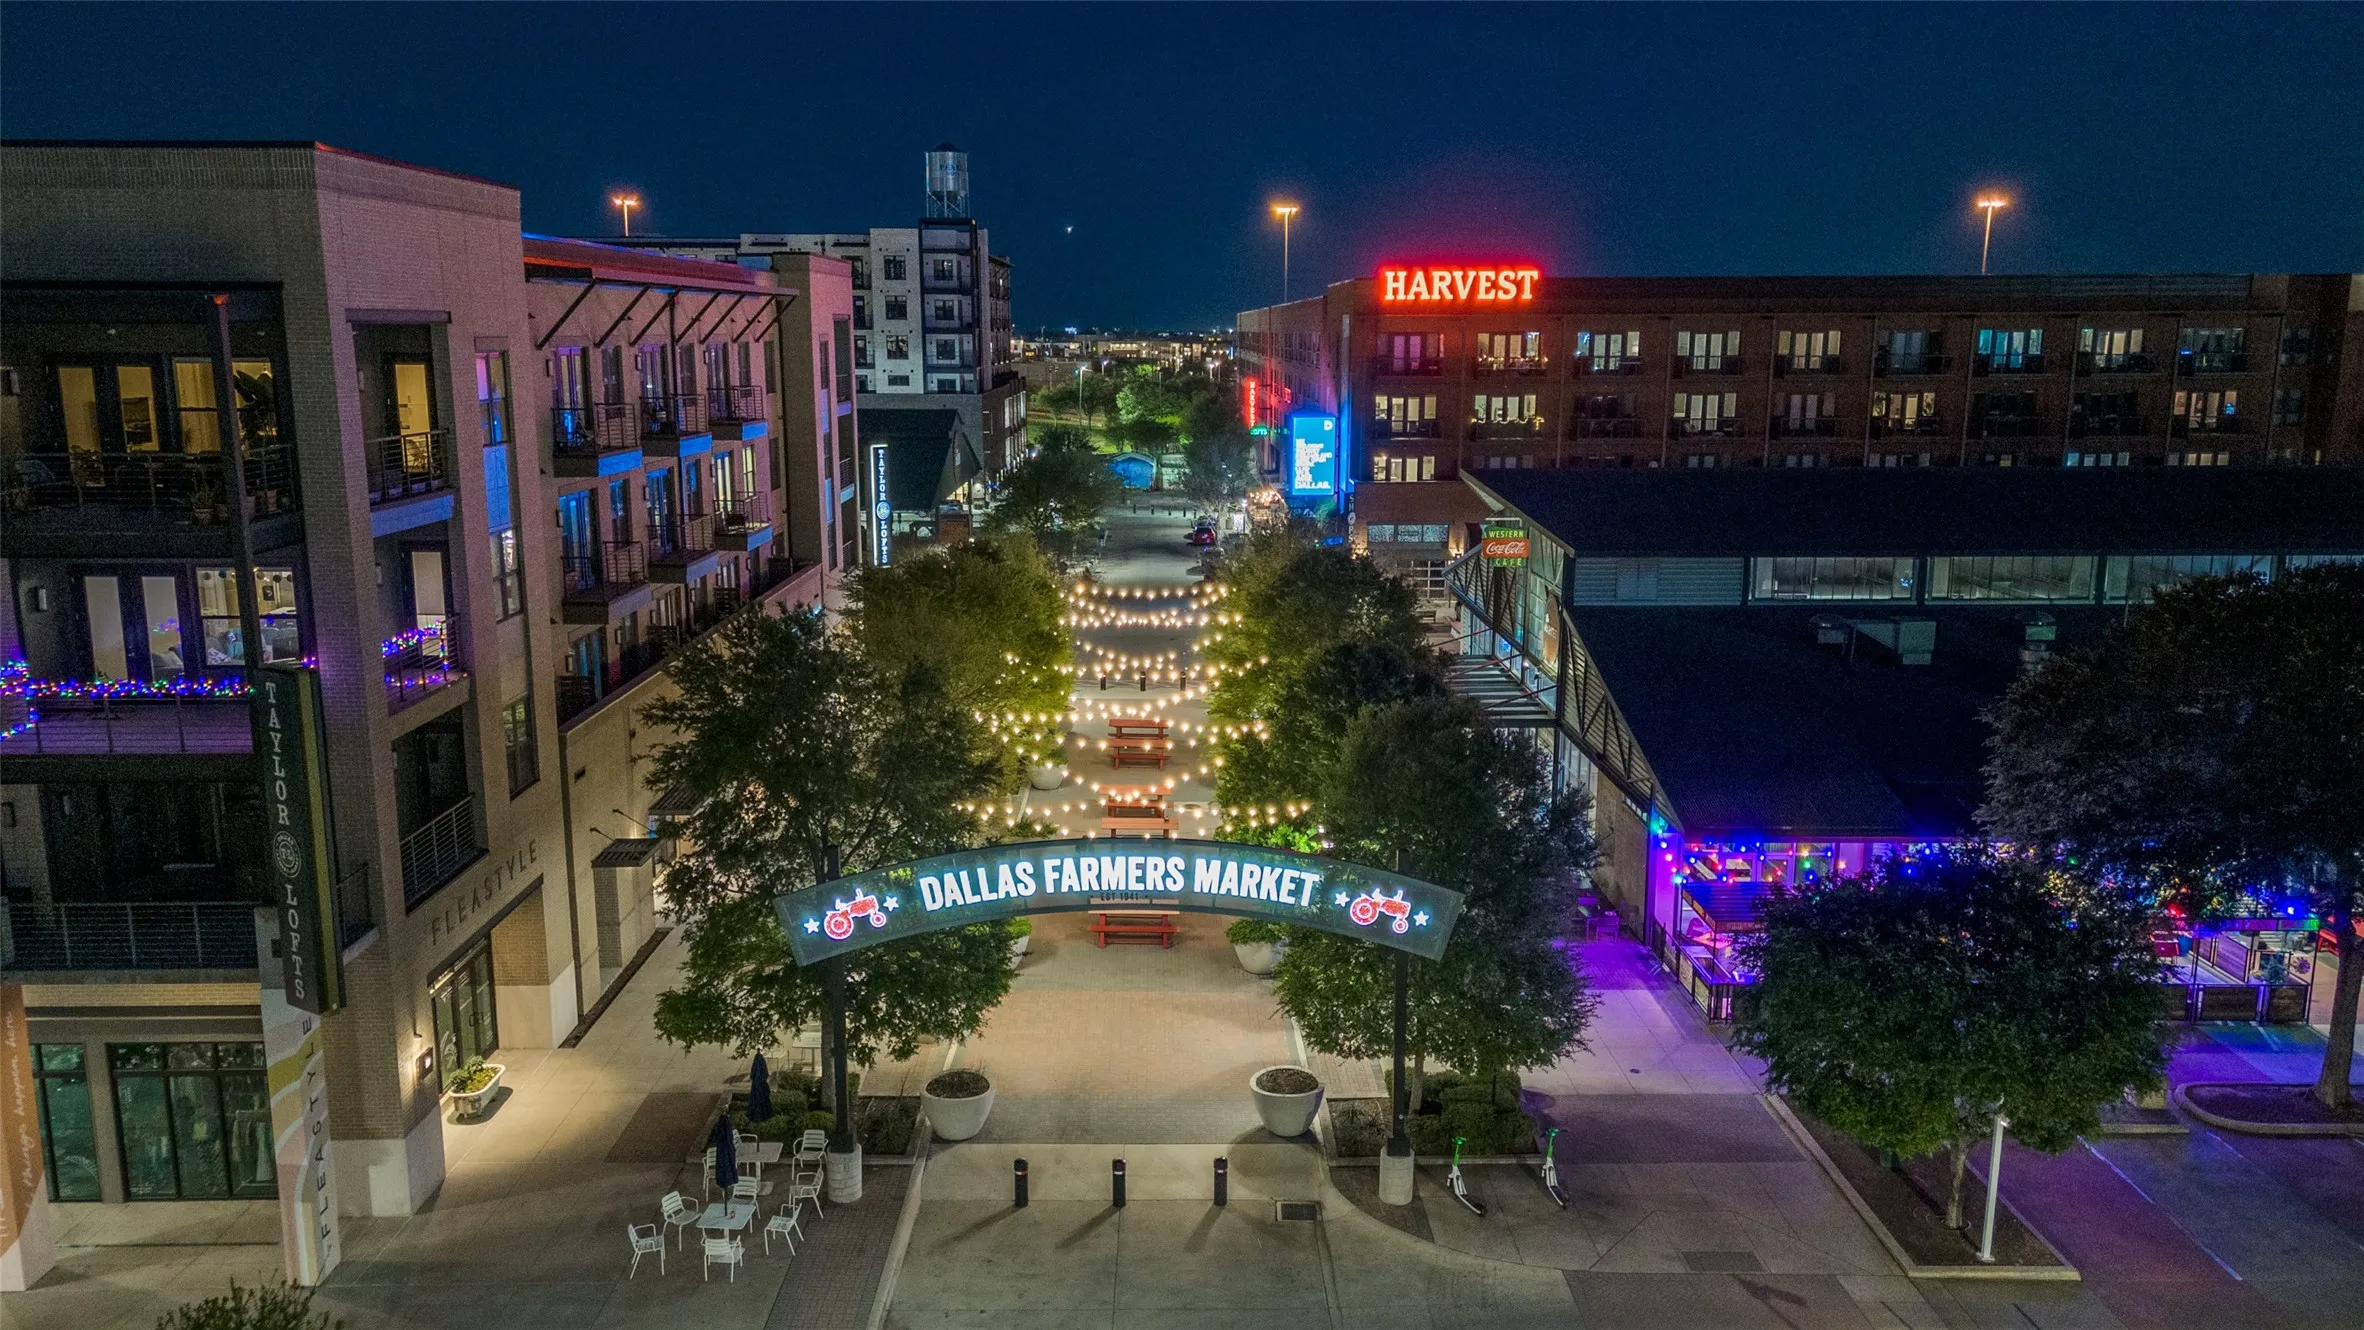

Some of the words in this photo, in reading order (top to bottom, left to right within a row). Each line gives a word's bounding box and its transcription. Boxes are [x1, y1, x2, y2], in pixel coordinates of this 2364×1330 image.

[1385, 270, 1539, 300] HARVEST
[1324, 420, 1333, 431] D
[878, 449, 886, 500] TAYLOR
[880, 521, 888, 563] LOFTS
[1348, 494, 1356, 543] SHOPS
[1488, 530, 1524, 538] WESTERN
[265, 682, 290, 825] TAYLOR
[285, 884, 305, 999] LOFTS
[432, 839, 537, 946] FLEASTYLE
[919, 861, 1037, 912] DALLAS
[1043, 856, 1187, 894] FARMERS
[1194, 859, 1320, 907] MARKET
[1100, 892, 1115, 901] EST
[1120, 892, 1139, 901] 1941
[302, 1015, 331, 1239] FLEASTYLE
